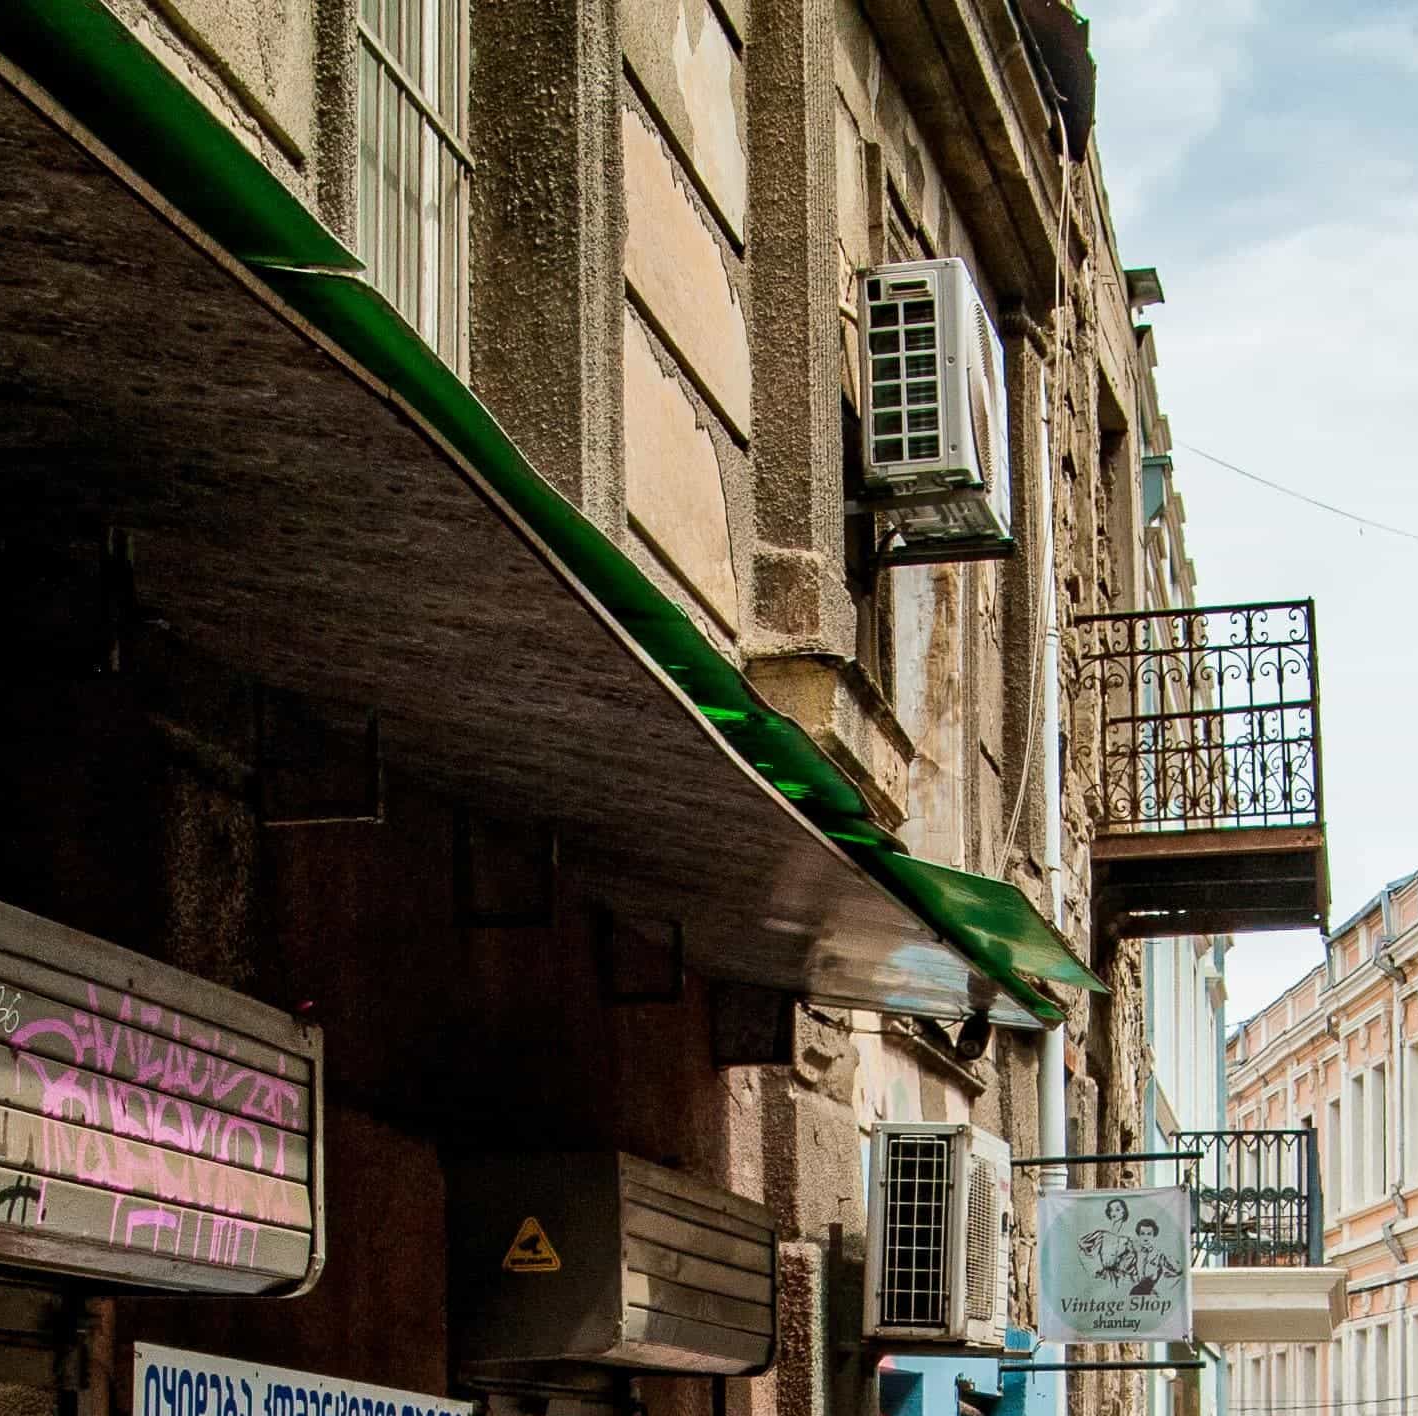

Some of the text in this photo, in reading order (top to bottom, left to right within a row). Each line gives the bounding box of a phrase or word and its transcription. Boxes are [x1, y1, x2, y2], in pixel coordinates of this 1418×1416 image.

[1060, 1295, 1172, 1317] Vintage Shop
[1092, 1315, 1142, 1333] shantay
